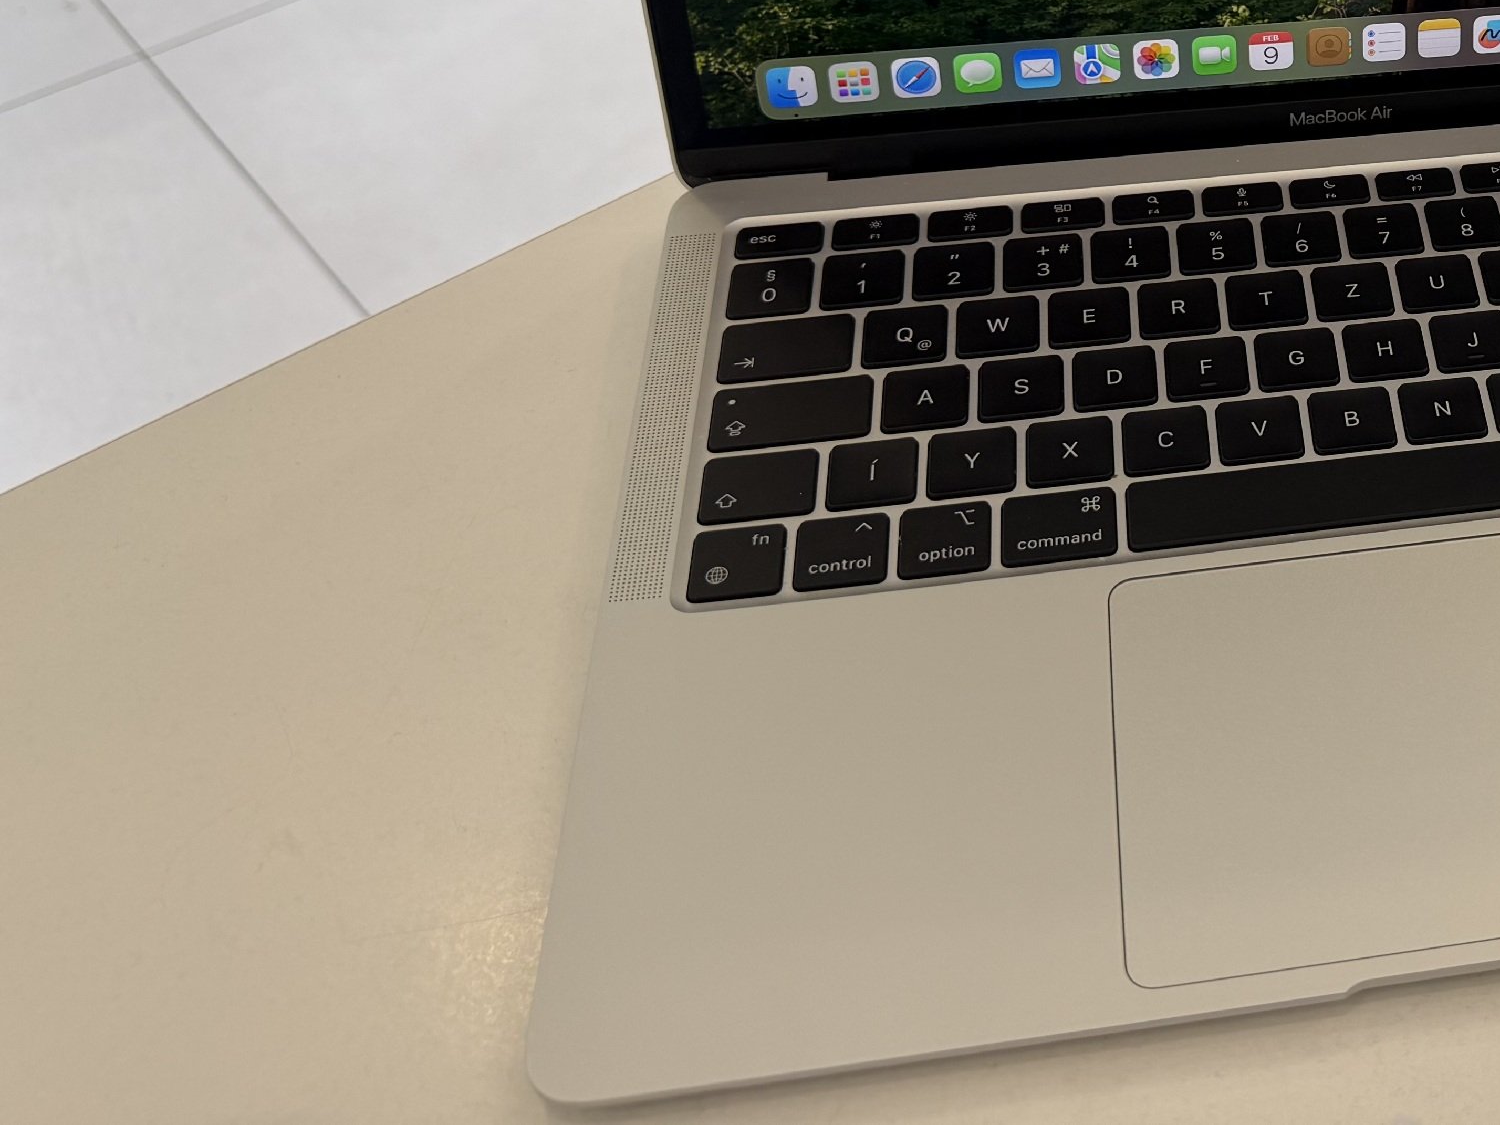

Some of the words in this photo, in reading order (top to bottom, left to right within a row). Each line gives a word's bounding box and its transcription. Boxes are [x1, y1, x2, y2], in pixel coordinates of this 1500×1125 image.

[1262, 34, 1279, 42] FEB
[1264, 46, 1279, 65] 9
[1290, 107, 1367, 127] MacBook
[1370, 105, 1392, 119] Air
[1378, 231, 1390, 245] 7
[1460, 223, 1474, 237] 8
[749, 234, 777, 244] esc
[1295, 239, 1309, 253] 6
[1124, 254, 1139, 268] 4
[1211, 246, 1225, 260] 5
[1037, 262, 1050, 277] 3
[947, 271, 961, 285] 2
[1429, 274, 1445, 289] U
[857, 279, 866, 294] 1
[1345, 283, 1361, 298] Z
[1258, 290, 1273, 306] T
[1171, 299, 1186, 315] R
[1083, 308, 1096, 324] E
[986, 317, 1010, 333] W
[896, 327, 914, 343] Q
[1467, 331, 1478, 348] J
[917, 339, 932, 351] @
[1376, 340, 1394, 357] H
[1288, 350, 1305, 366] G
[1200, 359, 1213, 375] F
[1106, 369, 1123, 385] D
[1014, 378, 1030, 395] S
[916, 389, 934, 405] A
[1433, 400, 1452, 417] N
[1344, 410, 1360, 427] B
[1251, 420, 1267, 437] V
[1158, 431, 1174, 448] C
[1062, 441, 1079, 459] X
[964, 452, 981, 469] Y
[751, 533, 770, 546] fn
[1017, 528, 1102, 550] command
[918, 545, 975, 563] option
[808, 555, 872, 575] control
